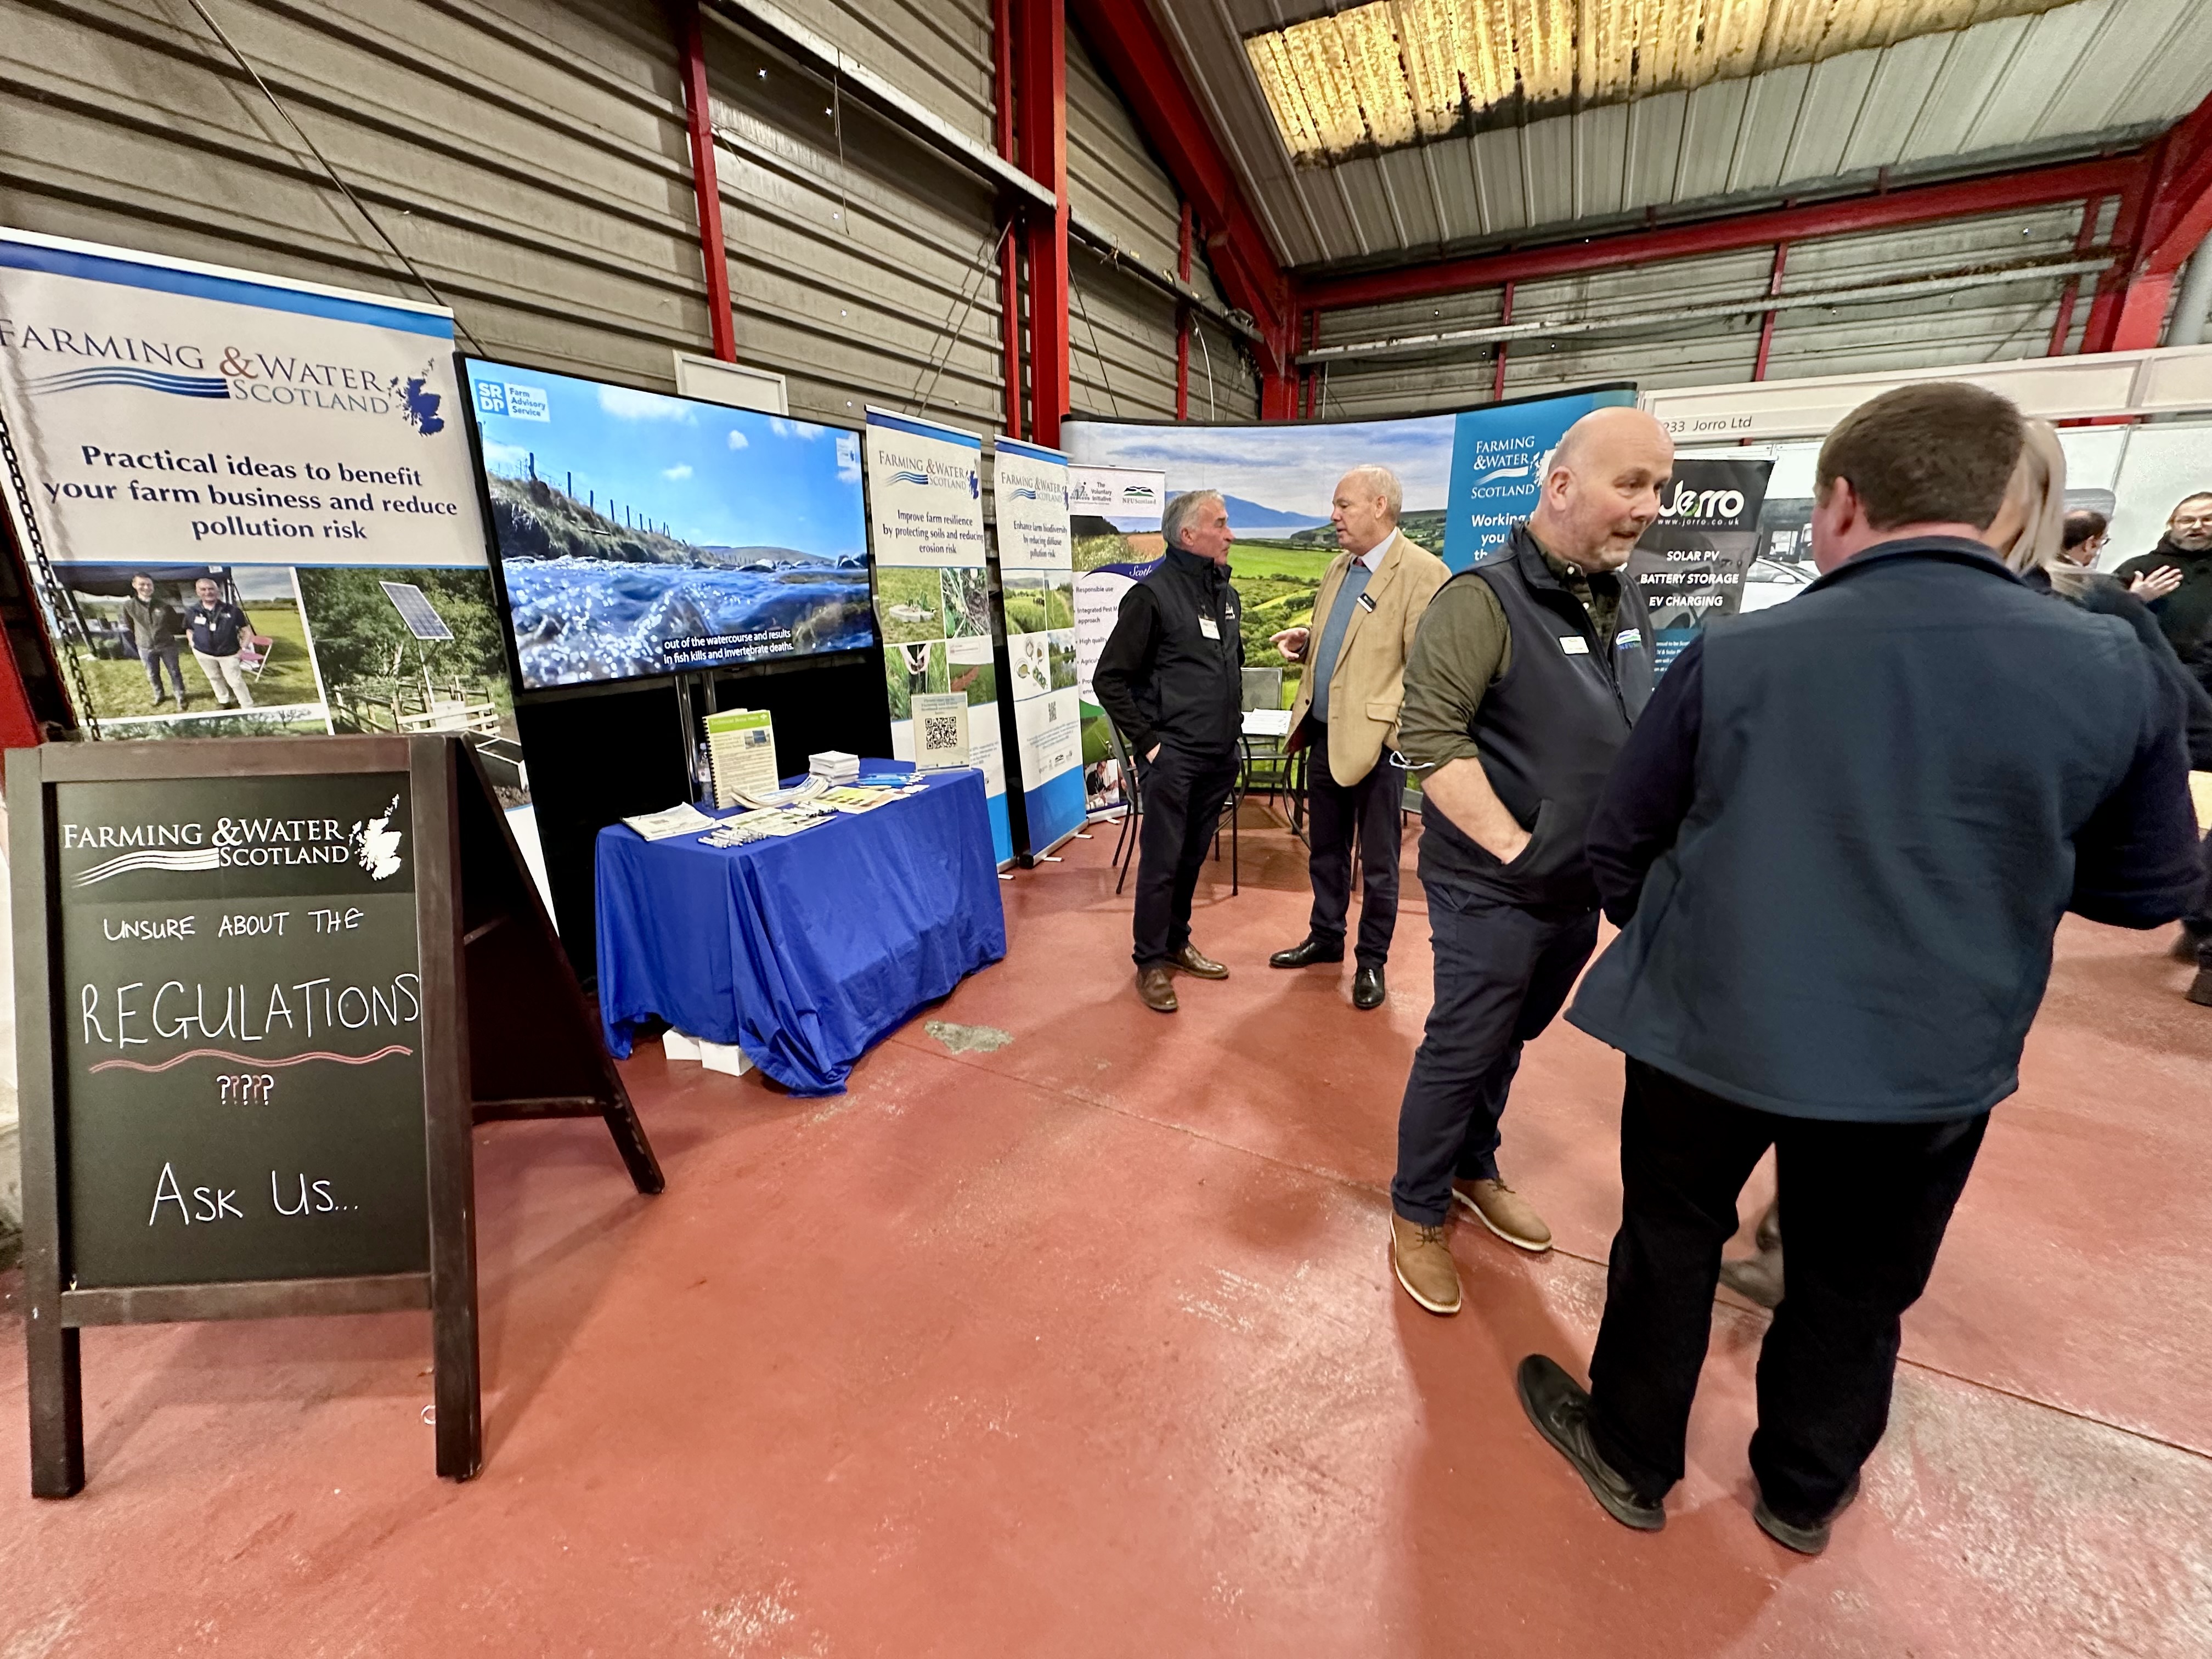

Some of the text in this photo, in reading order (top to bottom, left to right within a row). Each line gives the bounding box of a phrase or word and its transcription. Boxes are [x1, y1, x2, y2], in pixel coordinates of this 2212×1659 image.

[0, 318, 204, 371] FARMING
[234, 380, 389, 414] SCOTLAND
[510, 387, 530, 398] Farm
[511, 397, 546, 410] Advisory
[512, 407, 541, 416] Service
[1693, 420, 1726, 431] Jorro
[1731, 416, 1752, 428] Ltd
[1476, 436, 1535, 454] FARMING
[82, 445, 422, 487] Practical ideas to benefit
[879, 450, 923, 471] FARMING
[1474, 453, 1528, 470] &WATER
[929, 476, 966, 490] SCOTLAND
[1001, 472, 1032, 488] FARMING
[43, 479, 457, 516] your farm business and reduce
[1036, 493, 1062, 503] SCOTLAND
[1471, 483, 1535, 499] SCOTLAND
[1658, 480, 1745, 517] Jorro
[898, 509, 973, 526] Improve farm resilience
[1657, 518, 1739, 527] www.jorro.co.uk
[192, 516, 366, 540] pollution risk
[883, 524, 983, 544] by protecting soils and reducing
[1014, 521, 1067, 535] Enhance farm biodiversity
[919, 543, 957, 554] erosion risk
[1023, 534, 1062, 548] by reducing diffuse
[1030, 549, 1047, 559] pollution
[1667, 550, 1720, 561] SOLAR PV
[1640, 573, 1739, 584] BATTERY STORAGE
[1649, 596, 1723, 607] EV CHARGING
[1078, 617, 1101, 625] approach
[664, 629, 791, 649] out of the watercourse and results
[663, 642, 794, 664] in fish kills and invertebrate deaths.
[64, 822, 202, 849] FARMING
[219, 845, 349, 867] SCOTLAND
[104, 907, 364, 941] UNSURE ABOUT THE
[82, 973, 420, 1048] REGULATIONS
